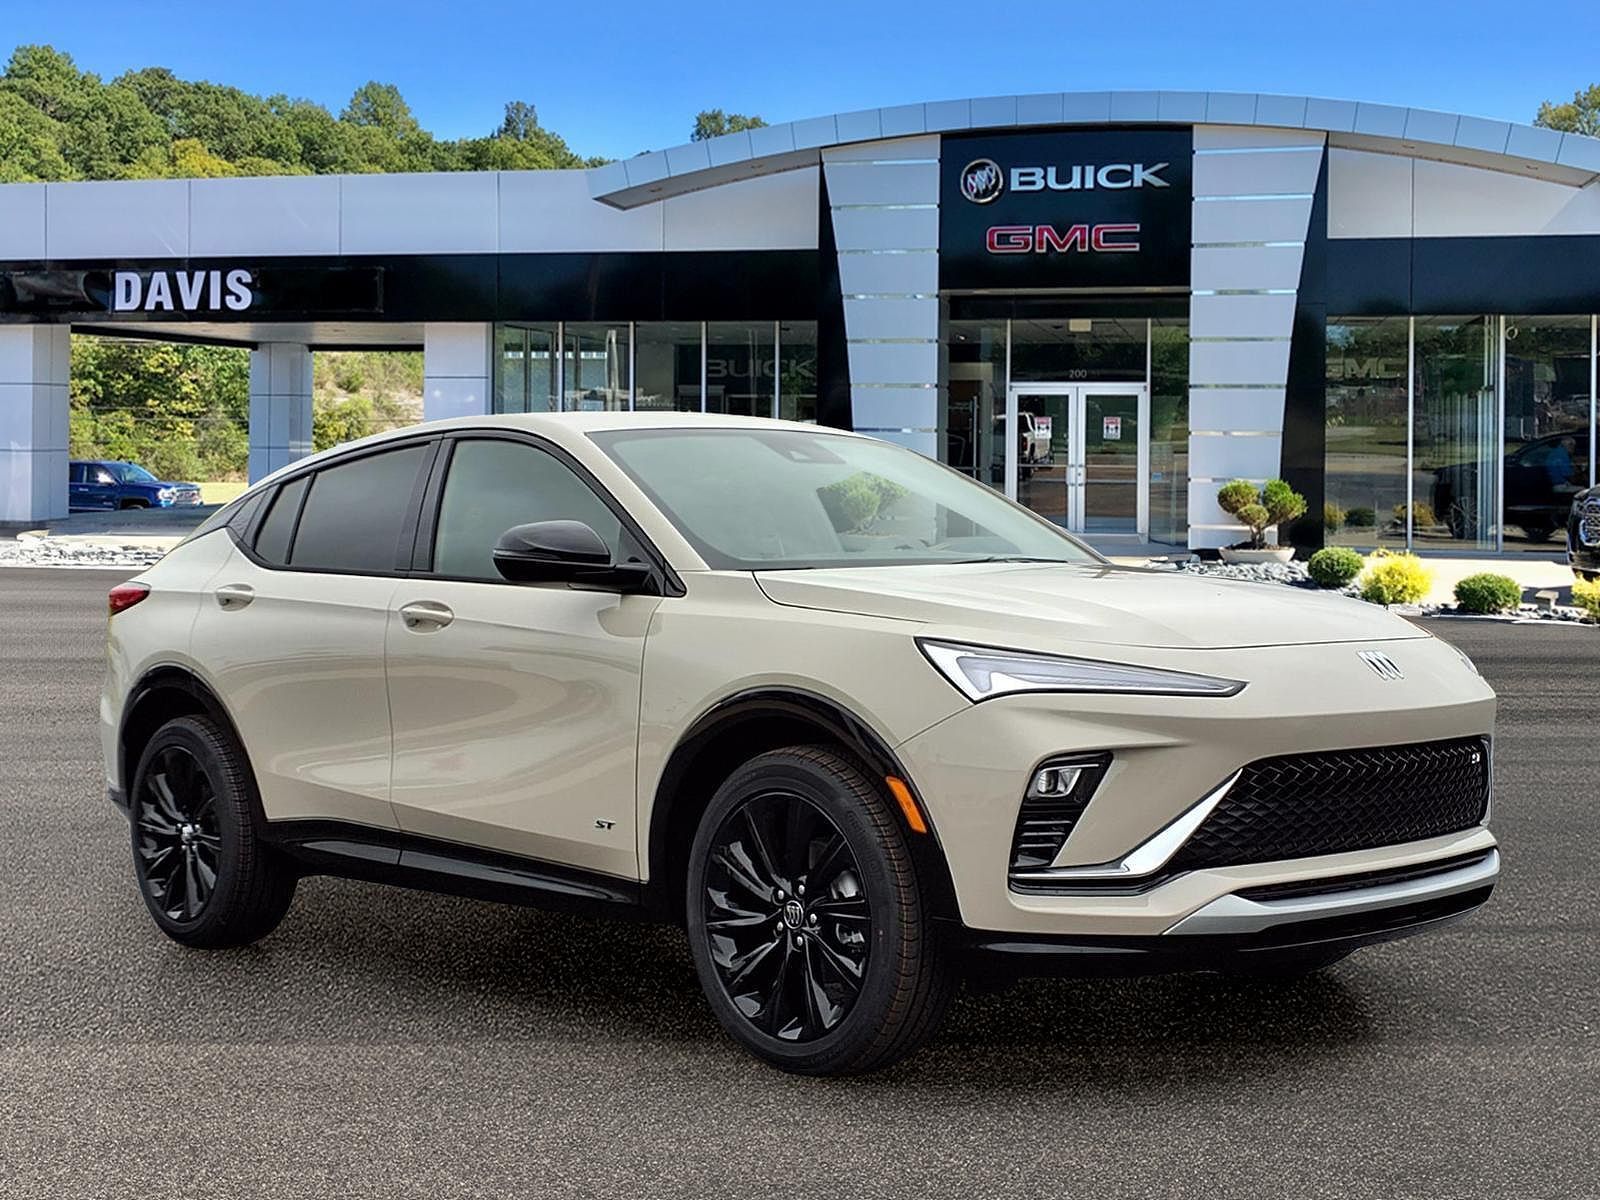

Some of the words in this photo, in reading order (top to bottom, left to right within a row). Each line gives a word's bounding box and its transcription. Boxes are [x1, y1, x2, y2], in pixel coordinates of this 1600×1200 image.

[1010, 162, 1170, 192] BUICK
[986, 223, 1140, 253] GMC
[114, 268, 254, 312] DAVIS
[1068, 369, 1087, 379] 200
[594, 819, 616, 830] ST
